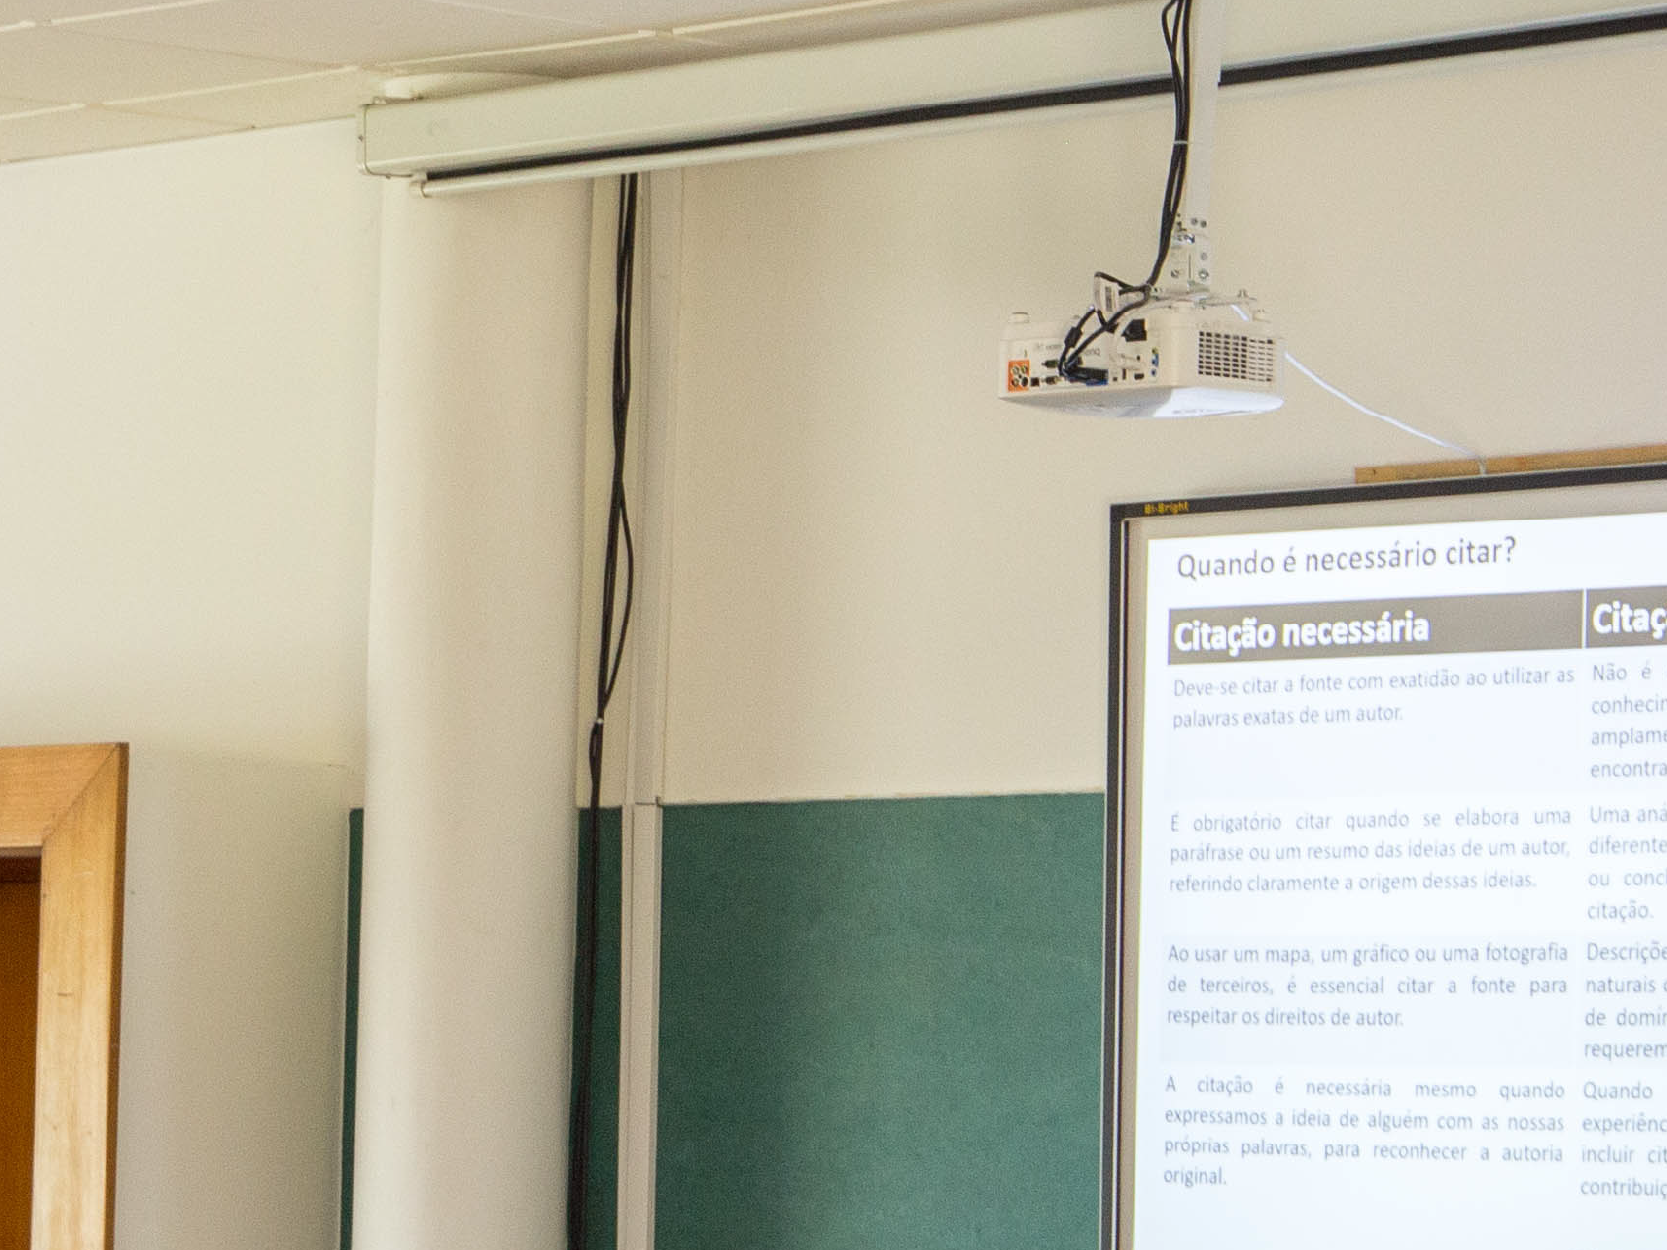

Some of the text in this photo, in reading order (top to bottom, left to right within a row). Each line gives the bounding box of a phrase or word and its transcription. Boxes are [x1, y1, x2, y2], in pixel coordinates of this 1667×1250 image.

[1177, 535, 1516, 581] Quando é necessário citar?
[1593, 602, 1667, 636] Citaç
[1173, 610, 1430, 657] Citação necessária
[1173, 667, 1575, 697] Deve-se citar a fonte com exatidão ao utilizar as
[1593, 660, 1652, 681] Não é
[1173, 705, 1402, 730] palavras exatas de um autor.
[1193, 812, 1282, 835] obrigatório
[1295, 813, 1332, 831] citar
[1346, 810, 1410, 832] quando
[1423, 813, 1441, 827] se
[1455, 807, 1519, 827] elabora
[1534, 810, 1571, 825] uma
[1589, 806, 1631, 824] Uma
[1170, 842, 1244, 865] paráfrase
[1248, 847, 1270, 862] ou
[1275, 846, 1302, 861] um
[1307, 845, 1369, 860] resumo
[1374, 840, 1403, 859] das
[1408, 838, 1456, 858] ideias
[1461, 838, 1483, 857] de
[1488, 842, 1517, 857] um
[1588, 835, 1667, 855] diferente
[1170, 870, 1536, 894] referindo claramente a origem dessas ideias.
[1587, 873, 1610, 888] ou
[1587, 899, 1654, 923] citação.
[1168, 941, 1568, 967] Ao usar um mapa, um gráfico ou uma fotografia
[1167, 975, 1567, 997] de terceiros, é essencial citar a fonte para
[1586, 975, 1657, 994] naturais
[1167, 1007, 1403, 1028] respeitar os direitos de autor.
[1584, 1007, 1606, 1027] de
[1165, 1075, 1565, 1102] A citação é necessária mesmo quando
[1583, 1081, 1653, 1101] Quando
[1165, 1108, 1565, 1133] expressamos a ideia de alguém com as nossas
[1164, 1135, 1563, 1162] próprias palavras, para reconhecer a autoria
[1581, 1144, 1635, 1164] incluir
[1163, 1166, 1227, 1189] original.
